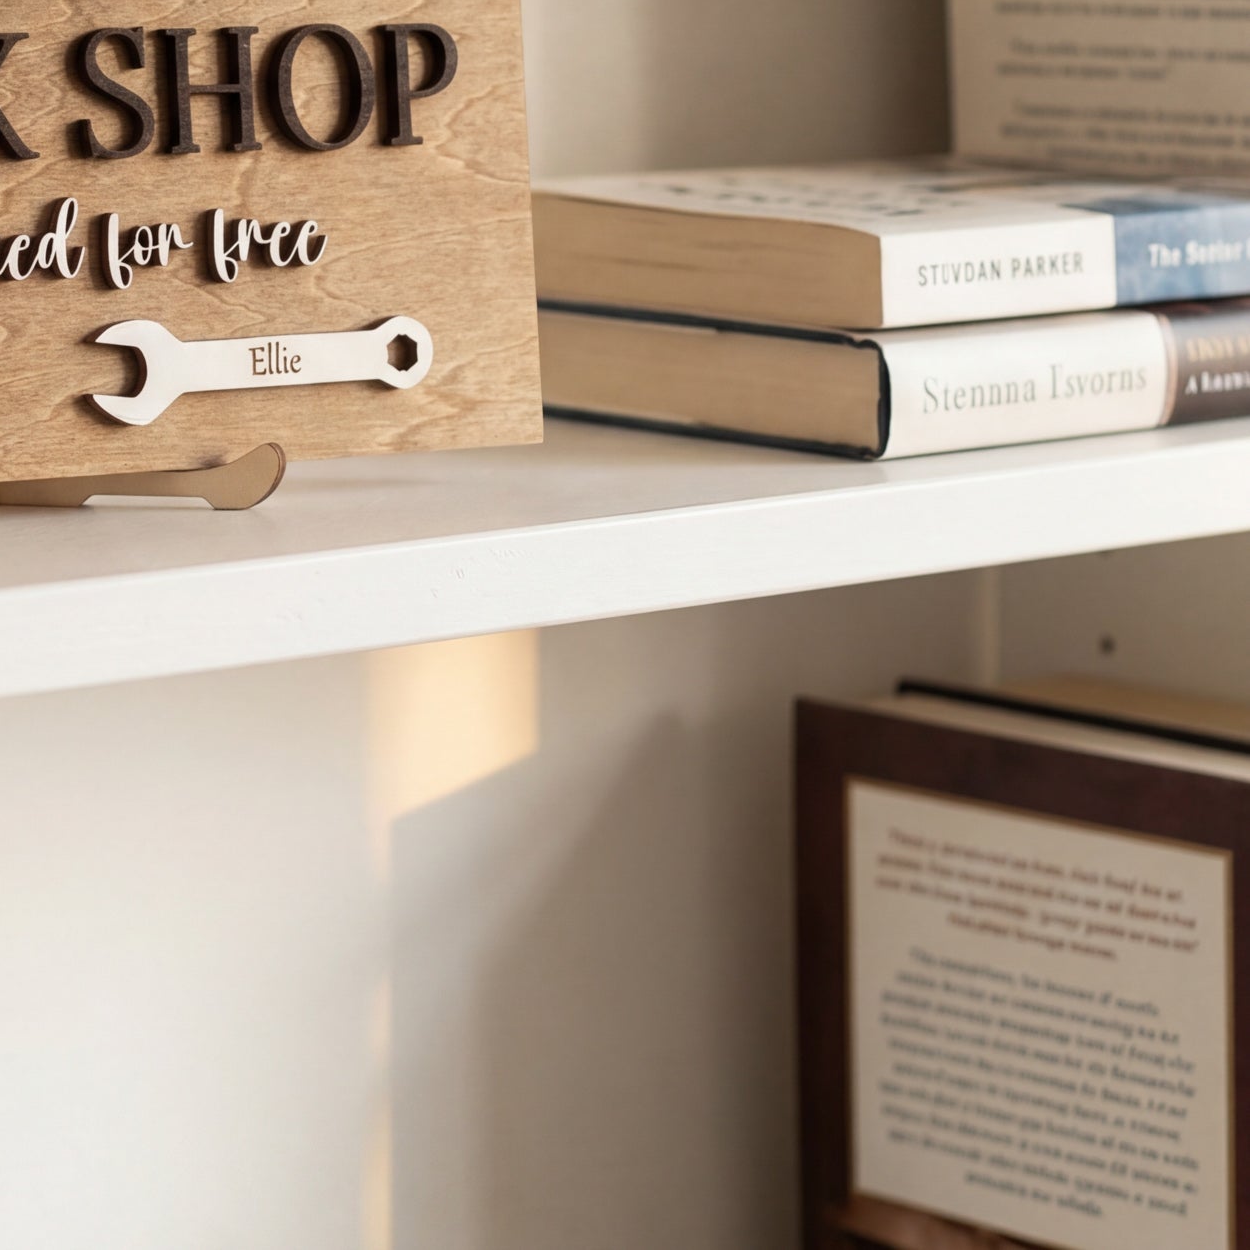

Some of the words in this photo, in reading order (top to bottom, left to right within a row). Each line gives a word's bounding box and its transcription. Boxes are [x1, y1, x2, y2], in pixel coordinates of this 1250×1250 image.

[77, 23, 458, 160] SHOP
[104, 213, 193, 290] for
[209, 208, 328, 284] free
[1011, 251, 1084, 279] PARKER
[1148, 242, 1181, 268] The
[248, 342, 302, 376] Ellie
